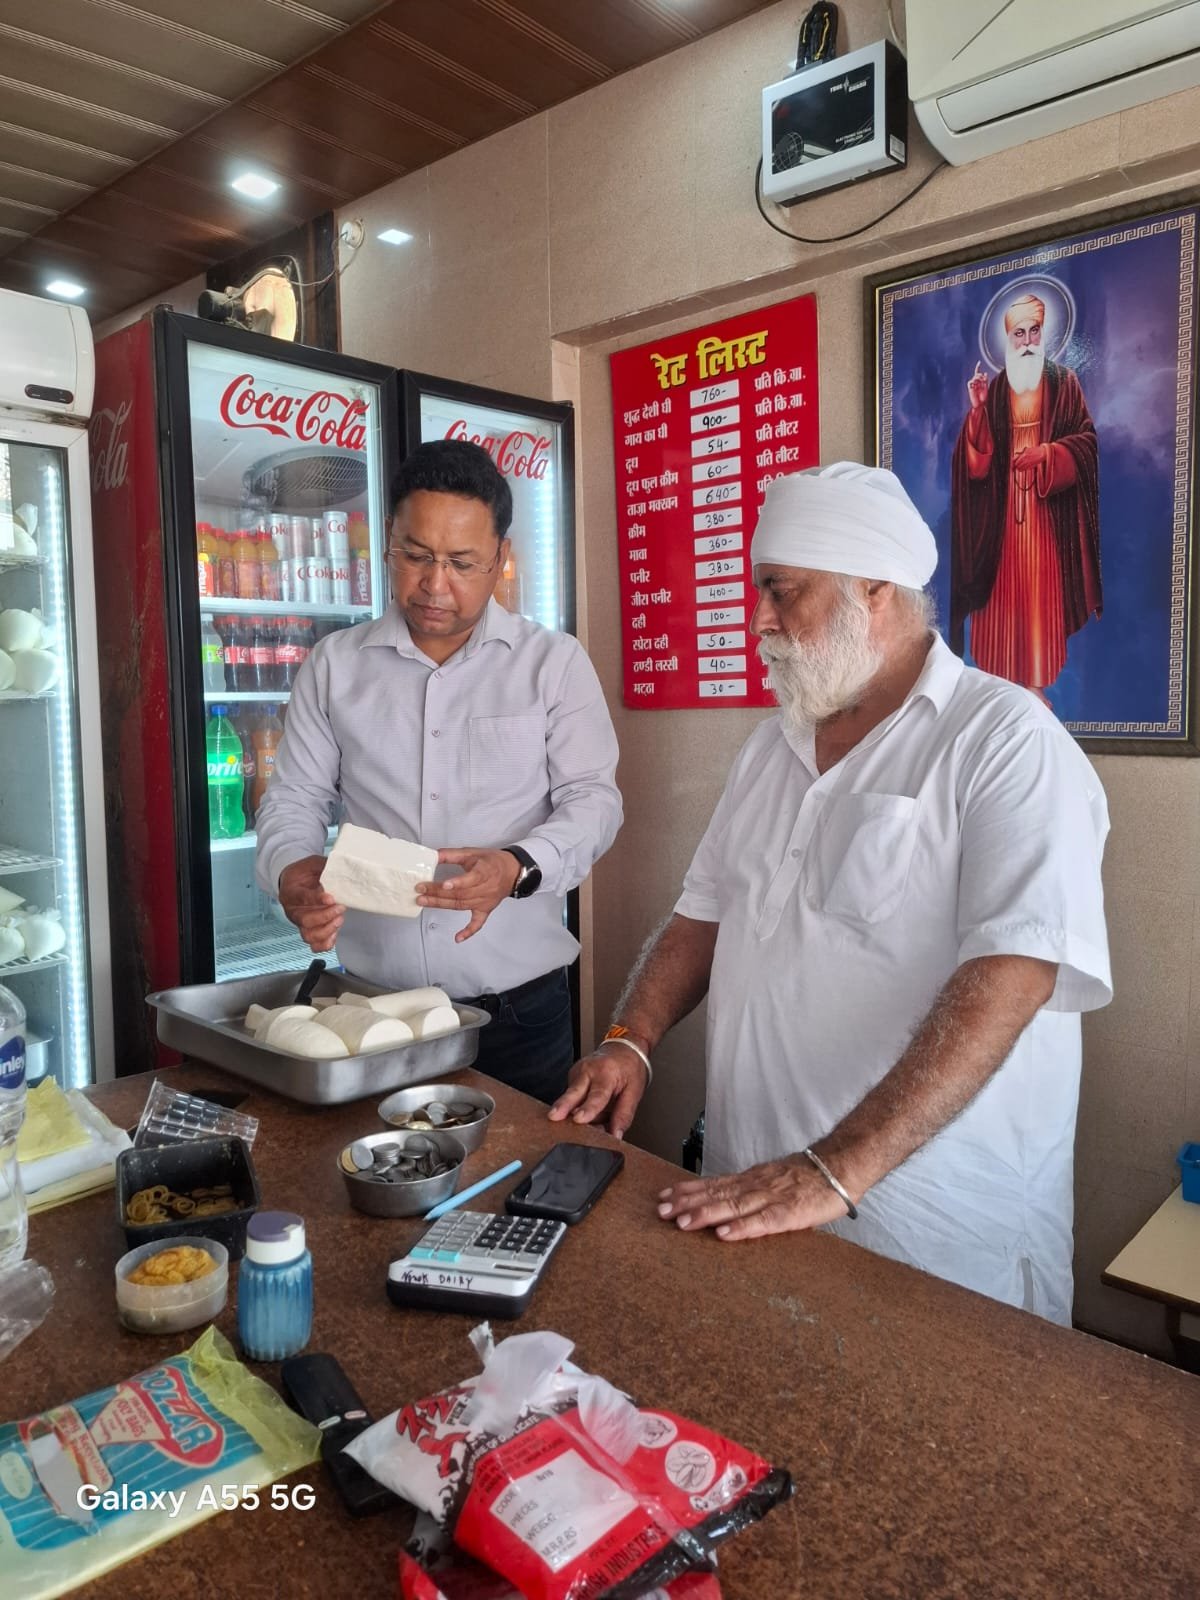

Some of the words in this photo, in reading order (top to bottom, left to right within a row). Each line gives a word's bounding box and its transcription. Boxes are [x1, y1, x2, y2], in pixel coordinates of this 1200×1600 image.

[650, 352, 688, 389] रेट
[696, 330, 769, 379] लिस्ट
[754, 371, 772, 391] प्रति
[220, 373, 370, 450] Coca-Cola
[642, 400, 659, 419] देशी
[661, 397, 672, 414] घी
[755, 397, 772, 416] प्रति
[624, 432, 642, 446] गाय
[644, 429, 656, 442] का
[657, 422, 668, 438] घी
[756, 423, 772, 442] प्रति
[775, 419, 799, 438] लीटर
[625, 456, 638, 474] दूध
[756, 448, 773, 468] प्रति
[776, 445, 799, 464] लीटर
[626, 480, 639, 496] दूध
[642, 476, 658, 494] फुल
[660, 470, 678, 487] क्रीम
[628, 523, 646, 540] क्रीम
[629, 548, 648, 561] मावा
[630, 568, 650, 584] पनीर
[631, 591, 648, 606] जीरा
[650, 588, 672, 604] पनीर
[632, 613, 646, 629] दही
[654, 633, 668, 649] दही
[655, 655, 678, 672] लस्सी
[439, 1274, 474, 1290] DAIRY
[126, 1414, 146, 1437] BAGS
[510, 1500, 539, 1529] PIECES
